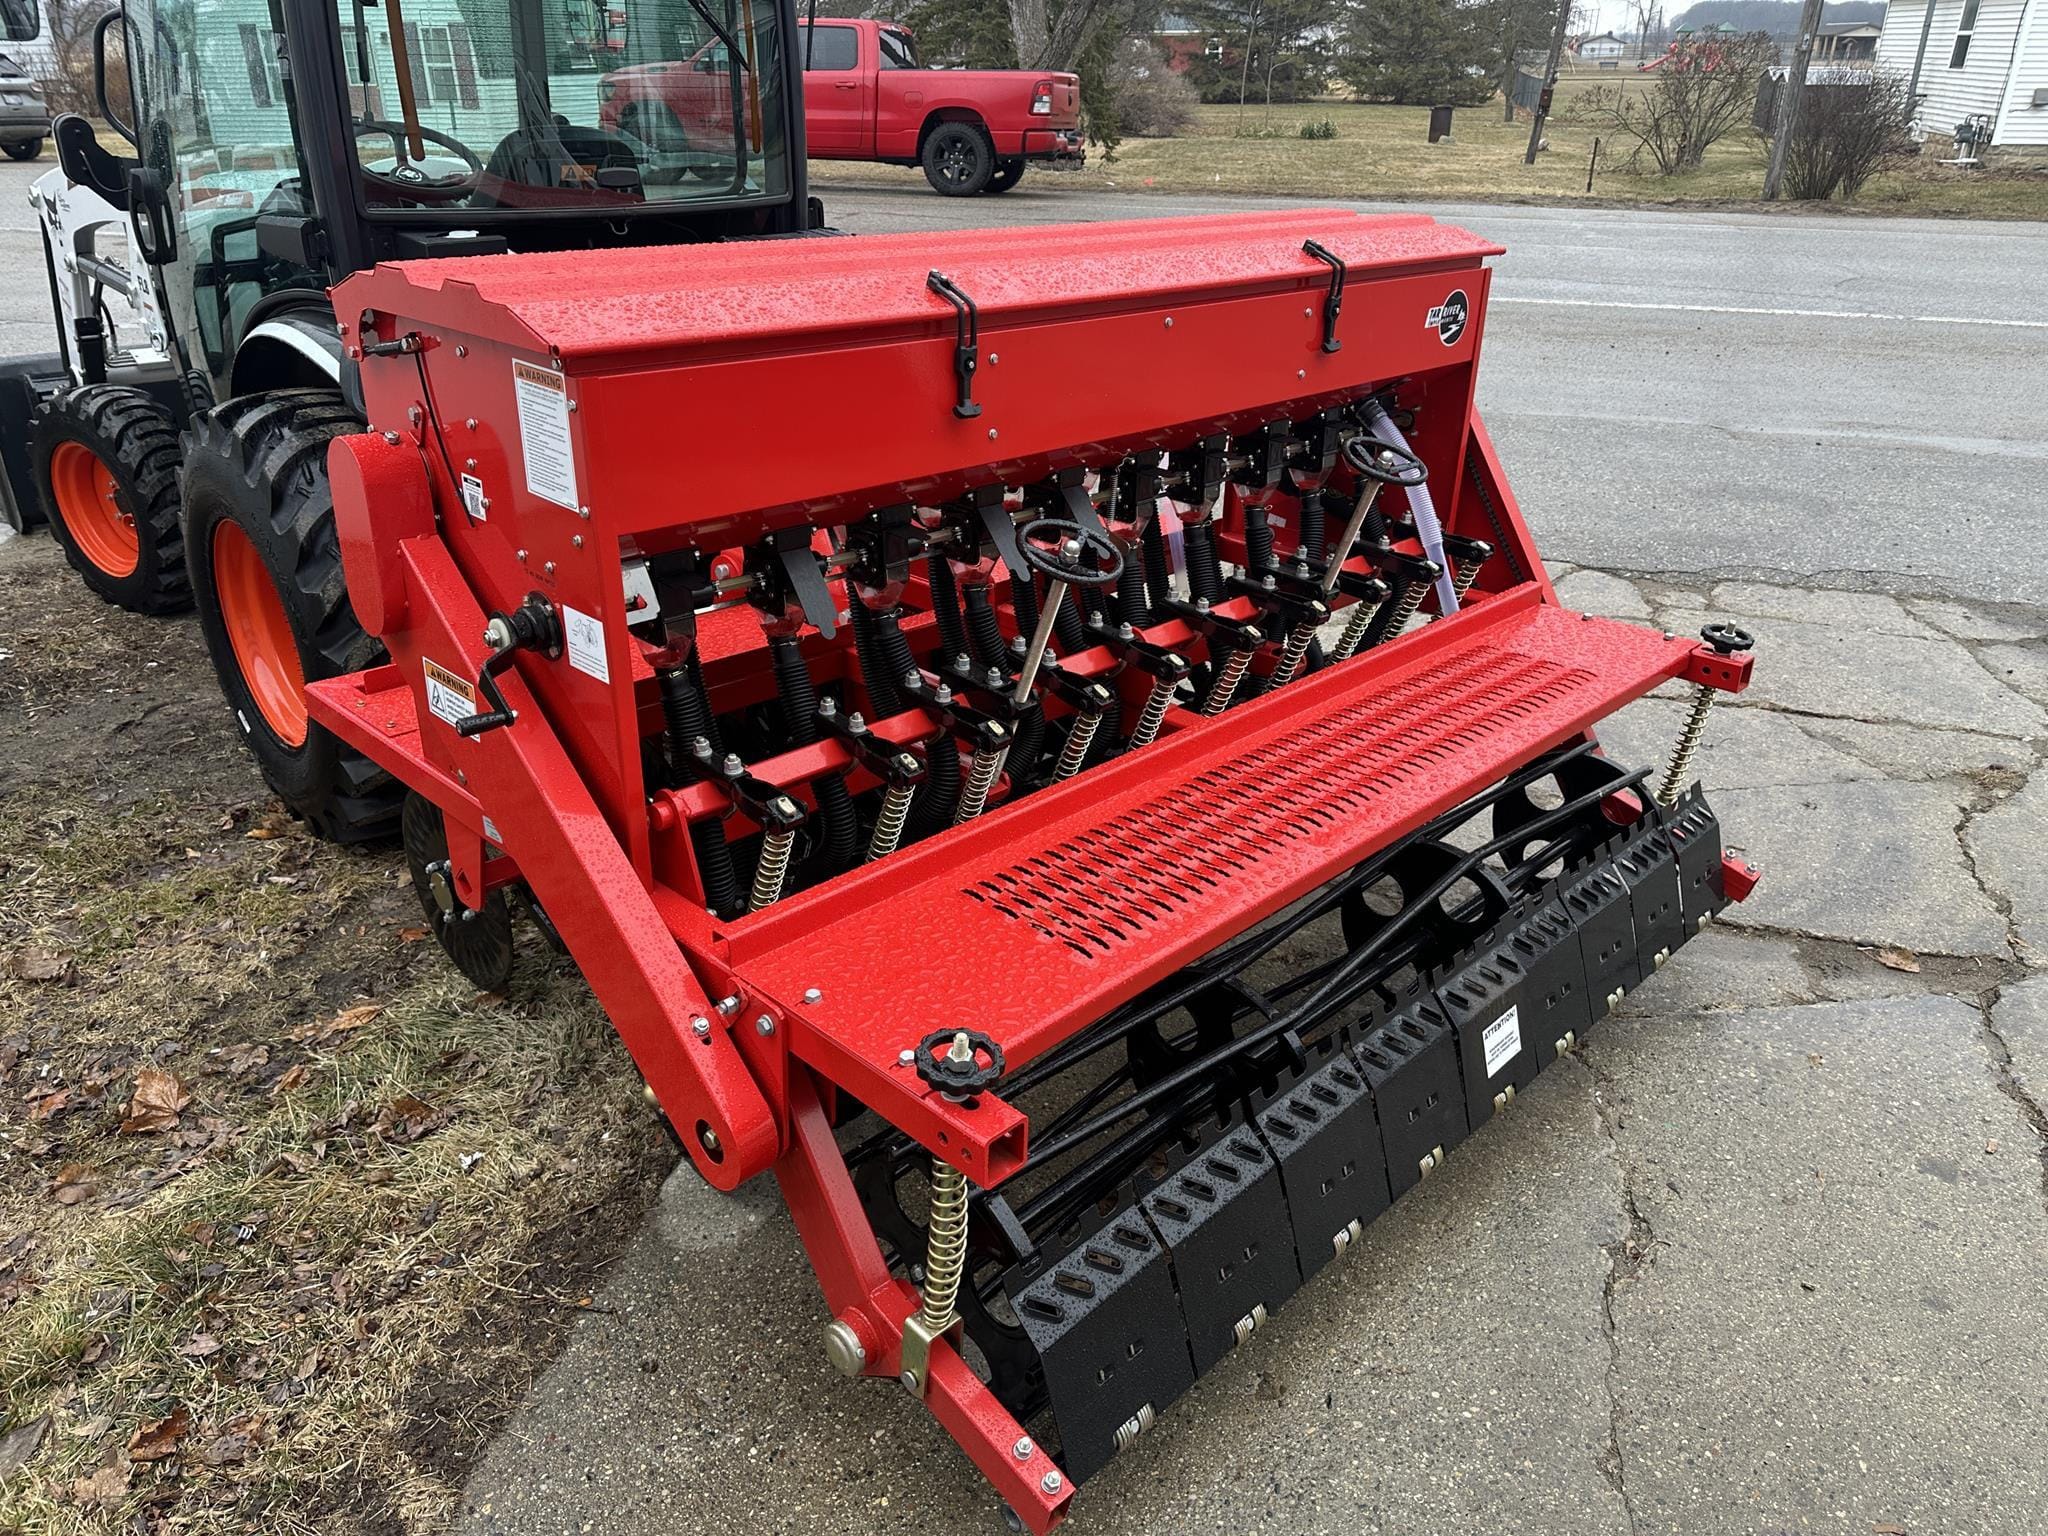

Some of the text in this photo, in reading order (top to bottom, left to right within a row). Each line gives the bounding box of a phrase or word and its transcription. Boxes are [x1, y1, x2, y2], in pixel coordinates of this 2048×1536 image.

[1442, 303, 1461, 317] RIVER
[524, 368, 562, 389] WARNING
[436, 669, 469, 696] WARNING
